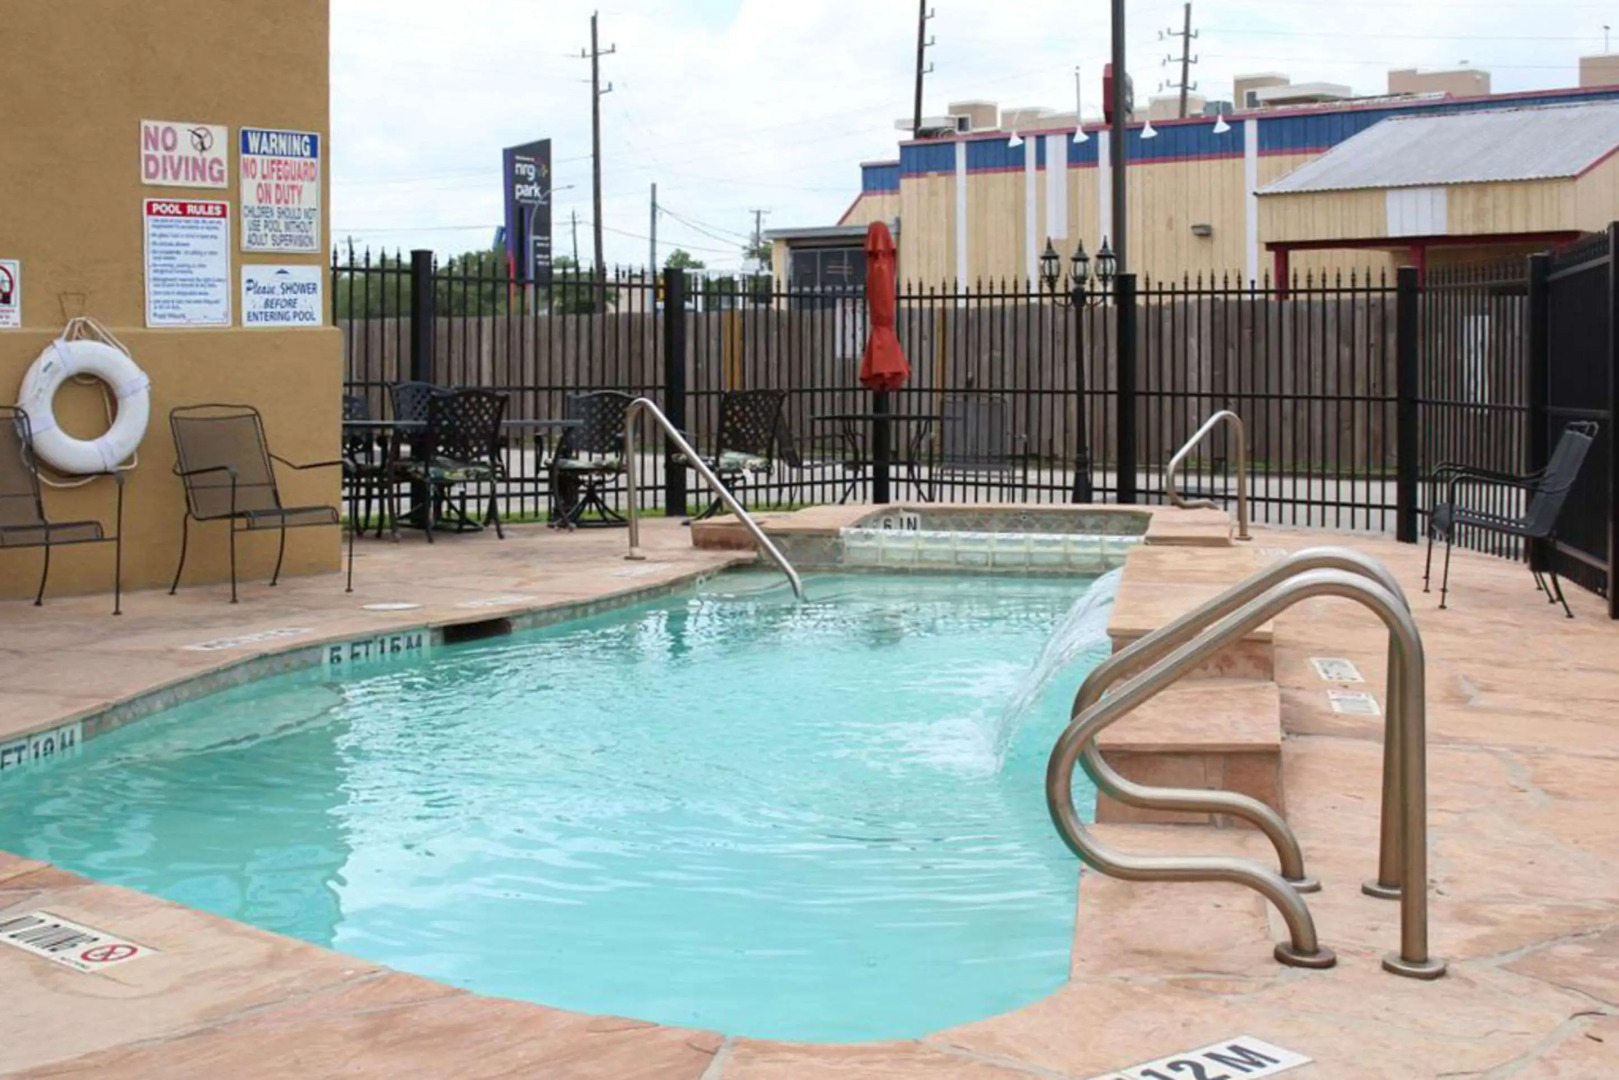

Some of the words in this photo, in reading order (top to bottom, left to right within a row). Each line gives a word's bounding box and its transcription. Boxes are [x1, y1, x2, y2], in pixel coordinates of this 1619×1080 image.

[144, 125, 178, 152] NO
[247, 132, 312, 157] WARNING
[144, 153, 225, 183] DIVING
[242, 158, 257, 180] NO
[261, 159, 317, 182] LIFEGUARD
[514, 162, 535, 181] nrg
[256, 183, 272, 205] ON
[275, 184, 303, 206] DUTY
[514, 182, 541, 201] park
[152, 203, 182, 215] POOL
[187, 204, 223, 216] RULES
[243, 206, 275, 220] CHILDREN
[276, 207, 301, 220] SHOULD
[303, 207, 318, 220] NOT
[247, 220, 261, 233] USE
[263, 220, 282, 233] POOL
[284, 220, 314, 234] WITHOUT
[247, 233, 268, 247] ADULT
[271, 234, 315, 248] SUPERVISION
[246, 278, 276, 295] Please
[280, 282, 318, 295] SHOWER
[263, 298, 299, 310] BEFORE
[246, 311, 291, 322] ENTERING
[292, 311, 317, 322] POOL
